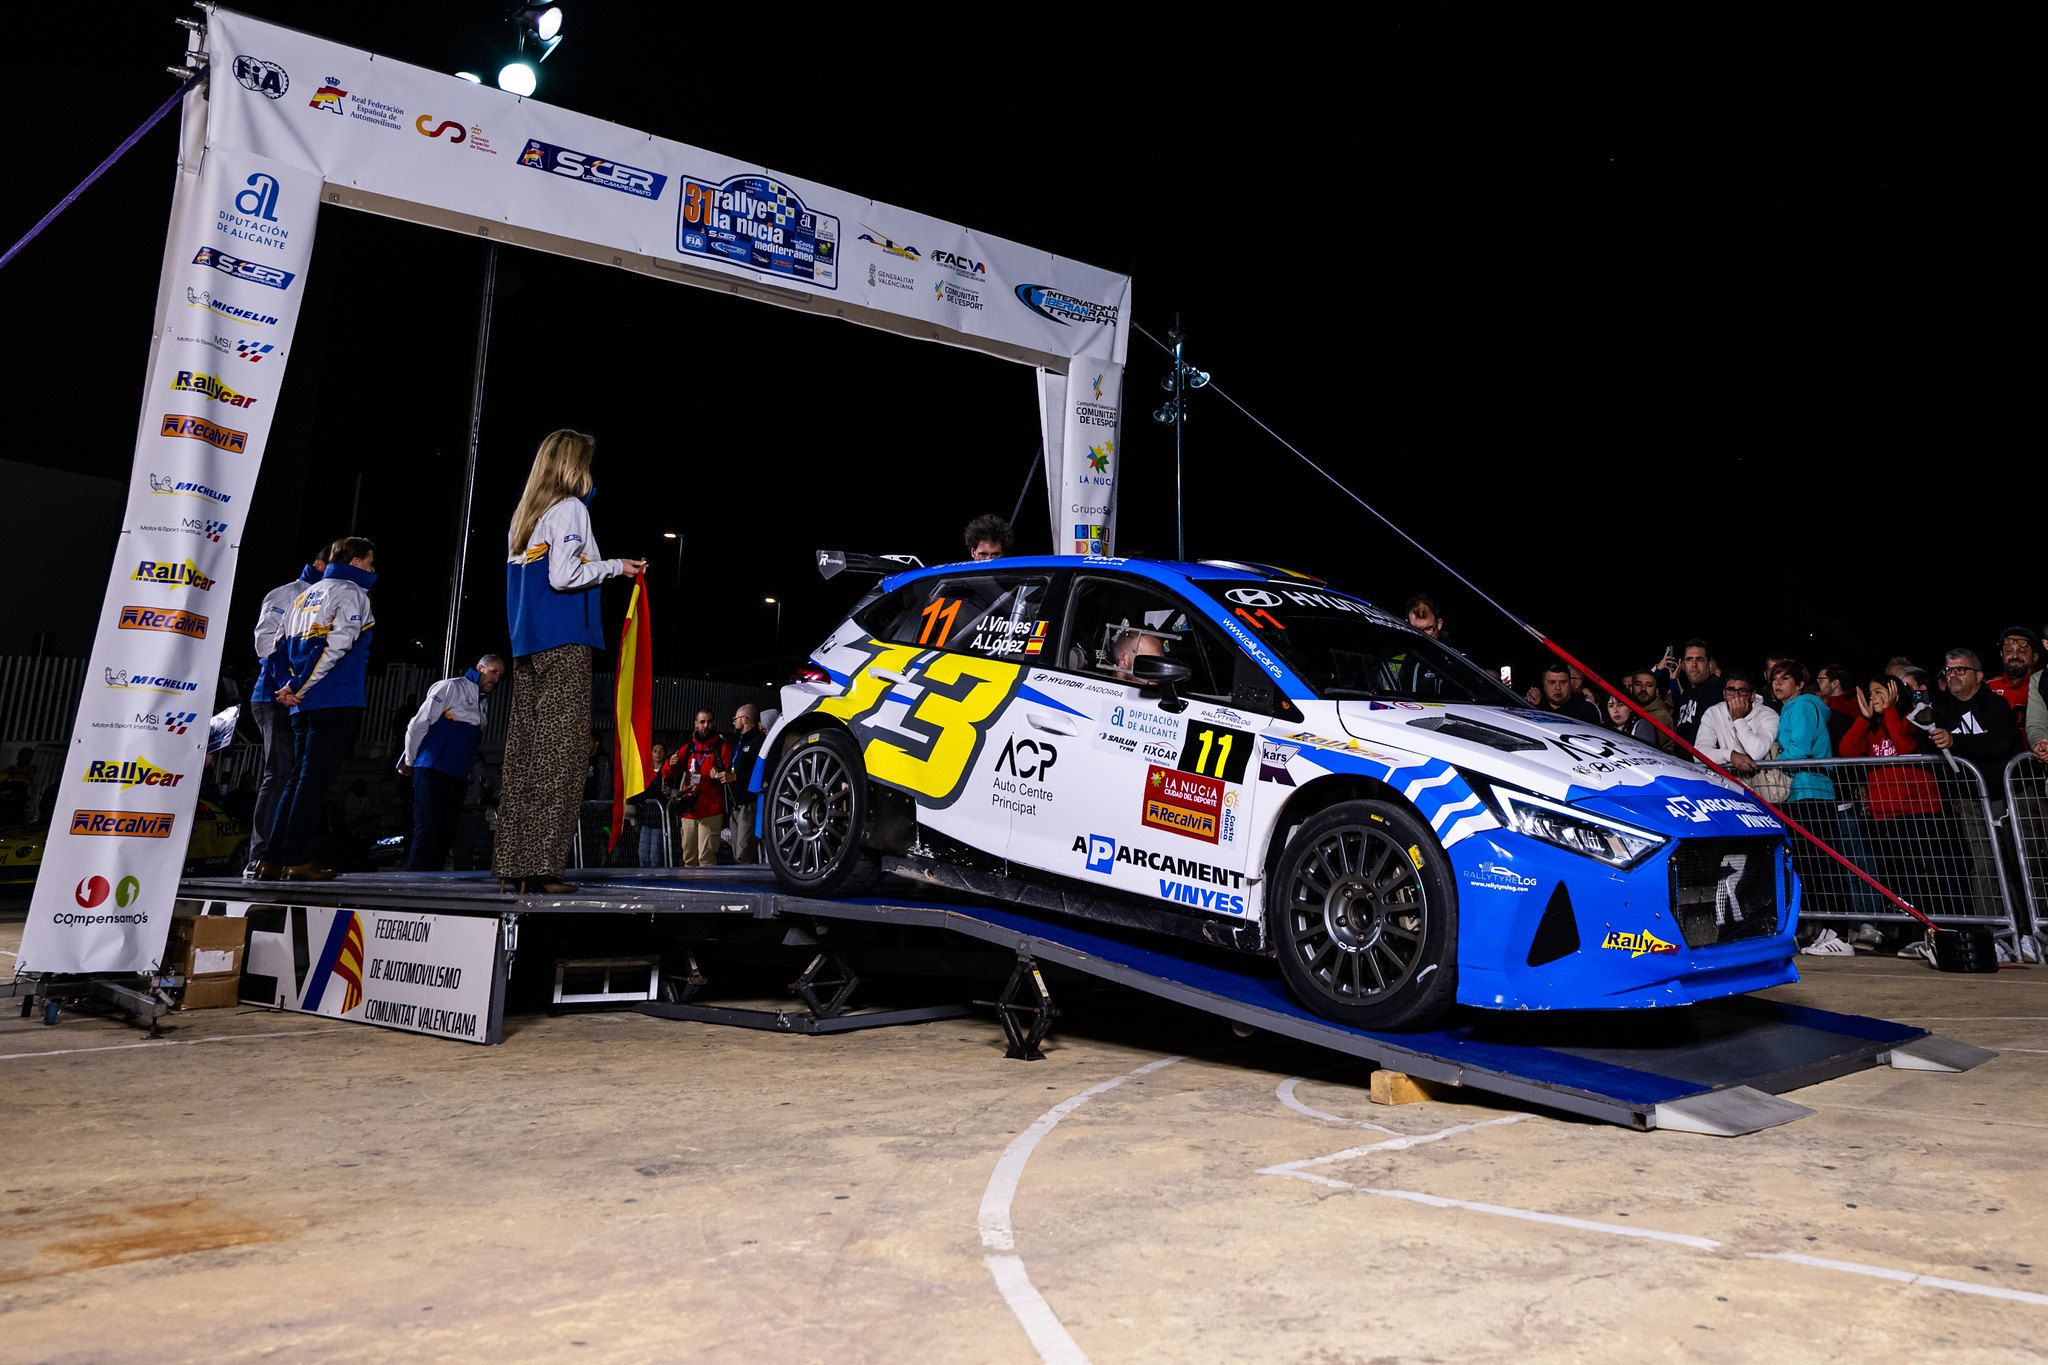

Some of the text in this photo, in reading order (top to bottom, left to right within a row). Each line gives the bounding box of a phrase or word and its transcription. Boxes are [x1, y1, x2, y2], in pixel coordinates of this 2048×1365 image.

[351, 95, 404, 115] Real Federación
[357, 104, 398, 121] Española de
[350, 111, 401, 130] Automovilismo
[552, 150, 655, 191] S-CER
[684, 183, 768, 226] 31 rallye
[219, 210, 289, 239] DIPUTACIÓN
[713, 208, 731, 231] la
[216, 222, 286, 250] DE ALICANTE
[216, 254, 286, 284] S-CER
[877, 270, 914, 285] GENERALITAT
[877, 277, 914, 291] VALENCIANA
[944, 286, 979, 302] COMUNITAT
[211, 299, 279, 325] MICHELIN
[946, 294, 984, 311] DE L'ESPORT
[176, 369, 258, 409] Rallycar
[1076, 407, 1117, 421] COMUNITAT
[1079, 415, 1091, 425] DE
[179, 418, 231, 446] Recalvi
[1079, 475, 1090, 484] LA
[175, 481, 232, 503] MICHELIN
[136, 560, 216, 592] Rallycar
[918, 597, 963, 648] 11
[976, 615, 1032, 637] J.Vinyes
[1234, 607, 1286, 630] 11
[969, 632, 1026, 655] A.López
[1222, 617, 1283, 679] www.rallycar.es
[130, 675, 198, 691] MICHELIN
[1047, 676, 1124, 698] HYUNDAI ANDORRA
[134, 713, 160, 725] MSi
[1129, 709, 1179, 728] DIPUTACIÓN
[1200, 709, 1252, 726] RALLYTYRELOG
[1107, 734, 1138, 748] SAILUN
[1127, 721, 1178, 740] DE ALICANTE
[1118, 745, 1135, 753] TYRE
[1142, 744, 1178, 761] FIXCAR
[1195, 730, 1233, 778] 11
[1263, 747, 1287, 763] kars
[88, 760, 185, 788] Rallycar
[1164, 777, 1175, 789] LA
[992, 776, 1054, 802] Auto Centre
[1164, 789, 1218, 807] CIUDAD DEL DEPORTE
[991, 794, 1037, 816] Principat
[88, 814, 160, 834] Recalvi
[1159, 807, 1203, 830] Recalvi
[1223, 808, 1232, 840] Blanca
[1463, 870, 1537, 886] RALLYTYRELOG
[1159, 878, 1244, 915] VINYES
[374, 915, 431, 943] FEDERACIÓN
[1607, 931, 1681, 955] Rallycar
[369, 958, 462, 990] DE AUTOMOVILISMO
[364, 998, 477, 1037] COMUNITAT VALENCIANA
